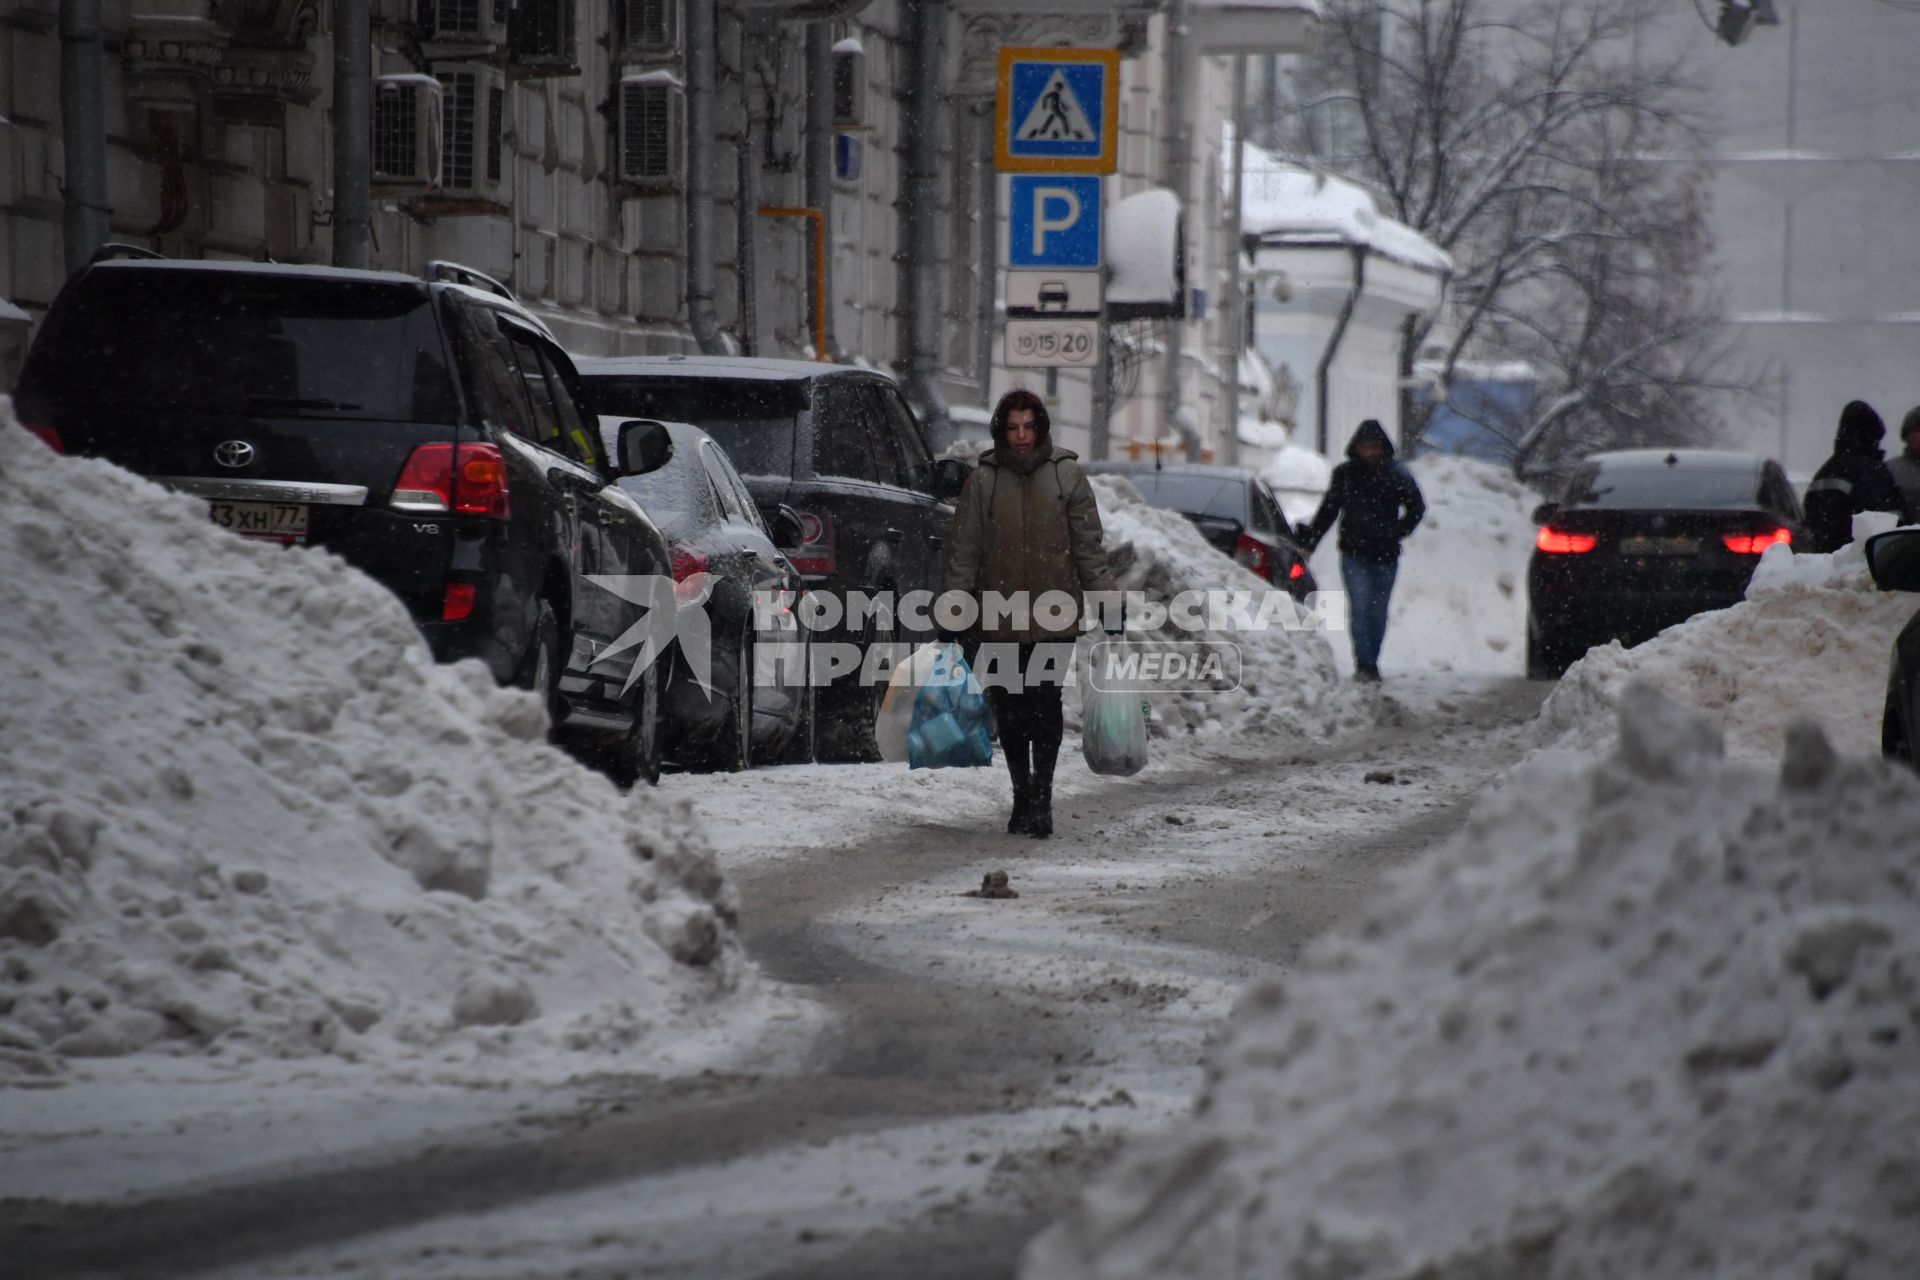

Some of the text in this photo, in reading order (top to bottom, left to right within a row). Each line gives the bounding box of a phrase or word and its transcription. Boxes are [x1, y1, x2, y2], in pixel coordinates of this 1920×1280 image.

[1032, 187, 1081, 257] P
[1018, 334, 1089, 353] 10 15 20
[413, 523, 440, 535] V8
